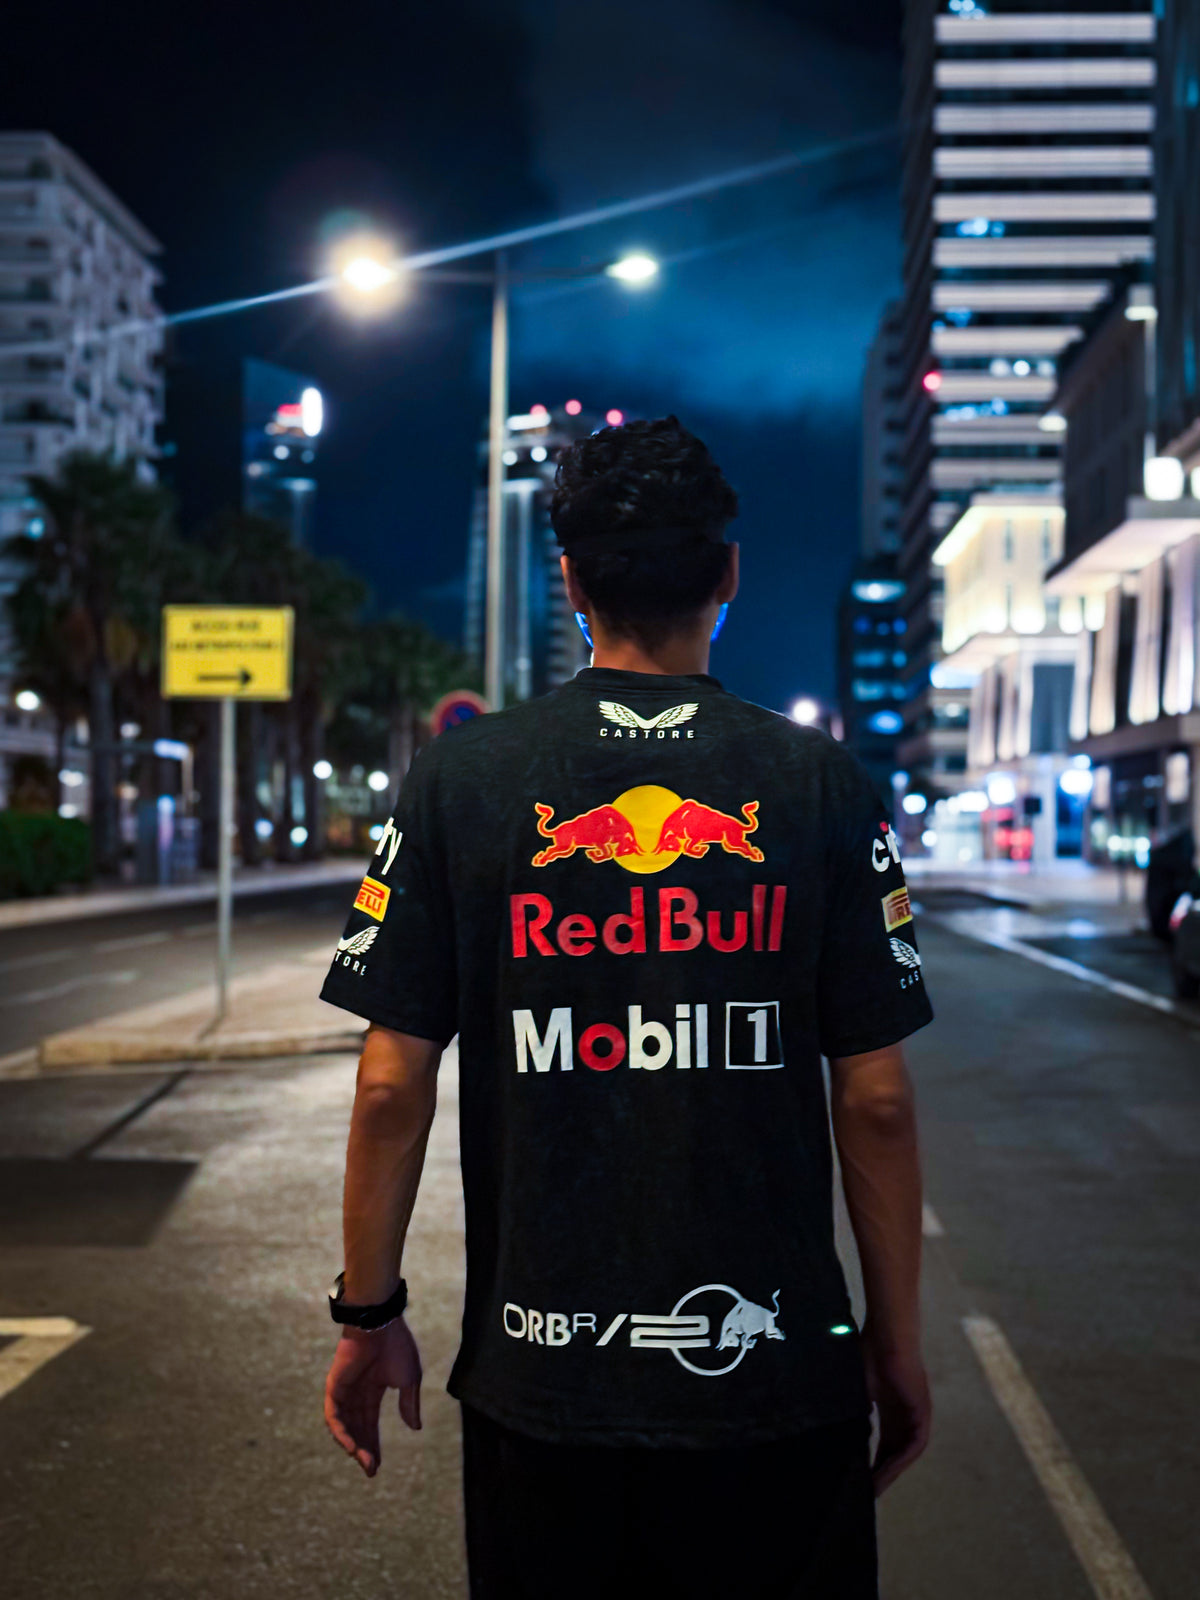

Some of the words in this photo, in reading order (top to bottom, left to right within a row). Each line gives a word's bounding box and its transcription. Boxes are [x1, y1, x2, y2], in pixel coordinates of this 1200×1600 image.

[600, 728, 695, 739] CASTORE
[510, 886, 647, 958] Red
[658, 884, 787, 953] Bull
[512, 1003, 709, 1072] Mobil
